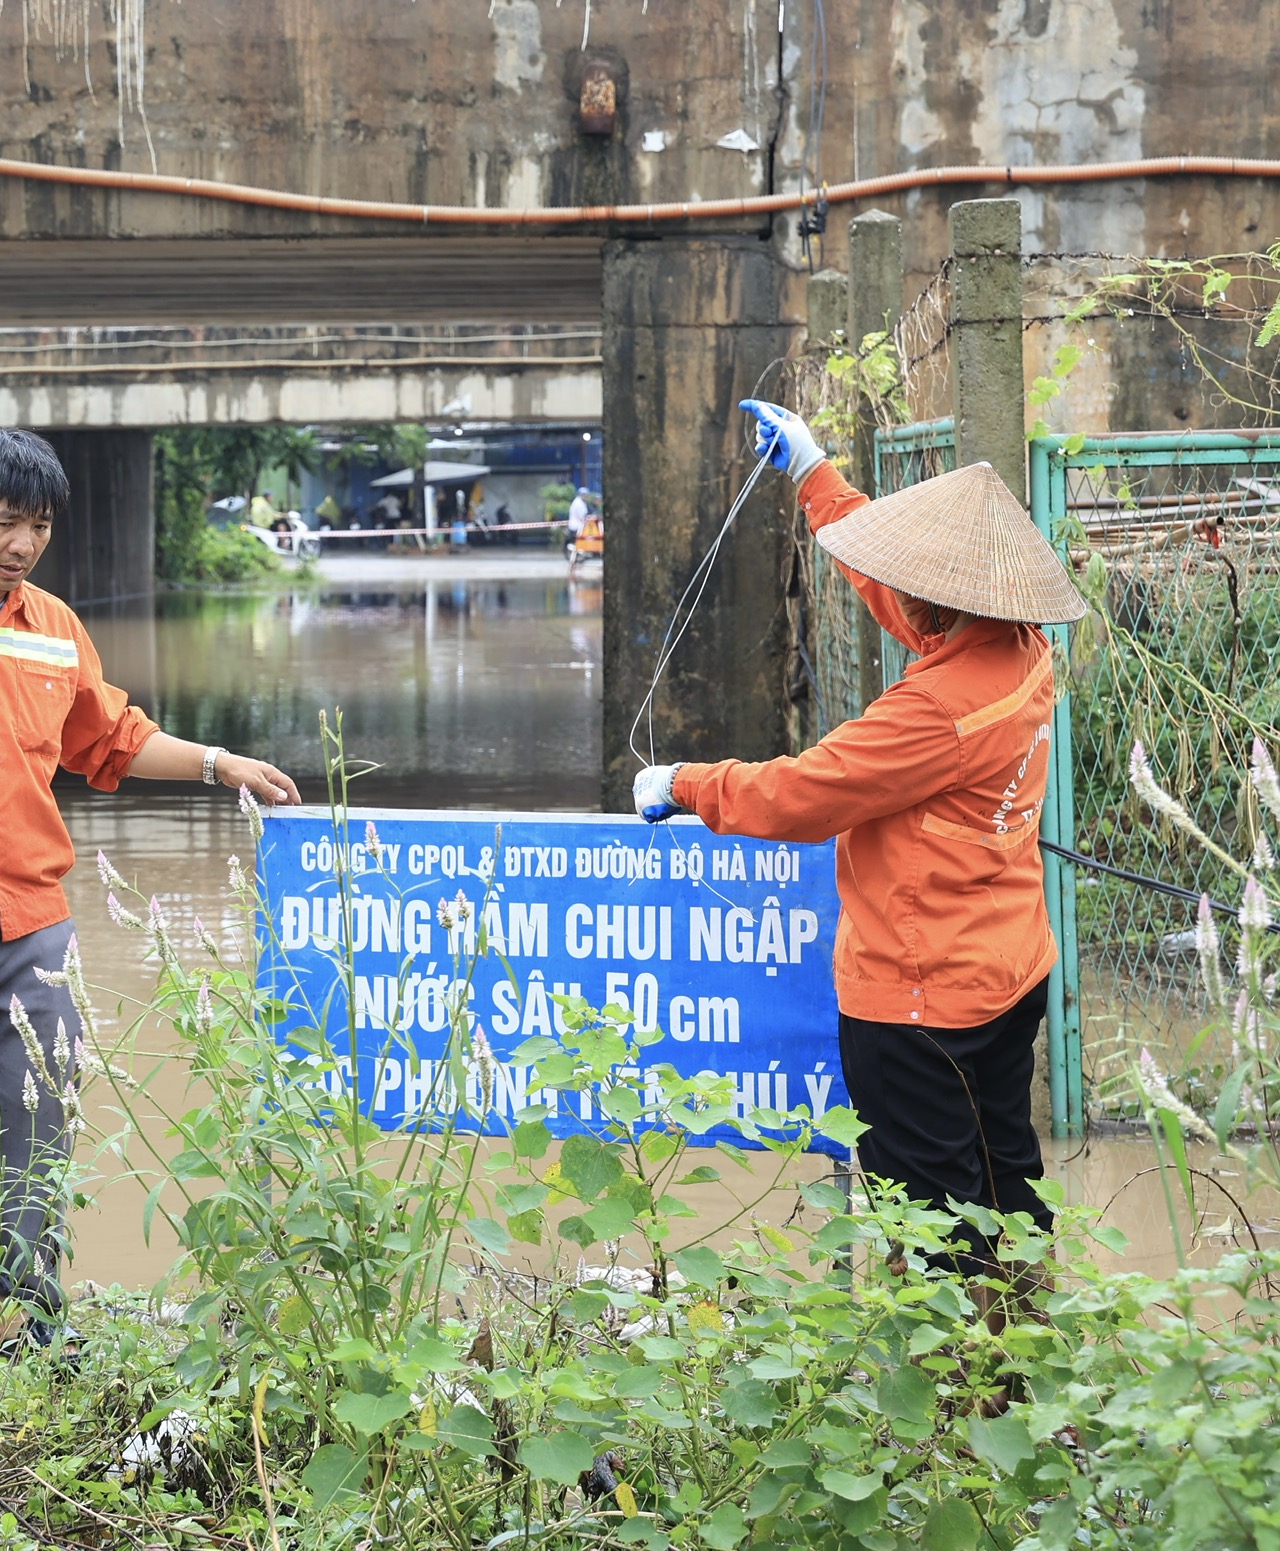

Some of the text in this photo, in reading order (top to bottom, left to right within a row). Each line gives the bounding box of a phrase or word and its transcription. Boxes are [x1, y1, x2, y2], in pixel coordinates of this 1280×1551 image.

[301, 835, 800, 888] CÔNG TY CPQL & ĐTXD ĐƯỜNG BỘ HÀ NỘI
[280, 883, 818, 976] ĐƯỜNG HẦM CHUI NGẬP
[354, 962, 740, 1042] NƯỚC SÂU 50 cm
[693, 1060, 788, 1127] HÚ
[803, 1062, 833, 1130] Ý
